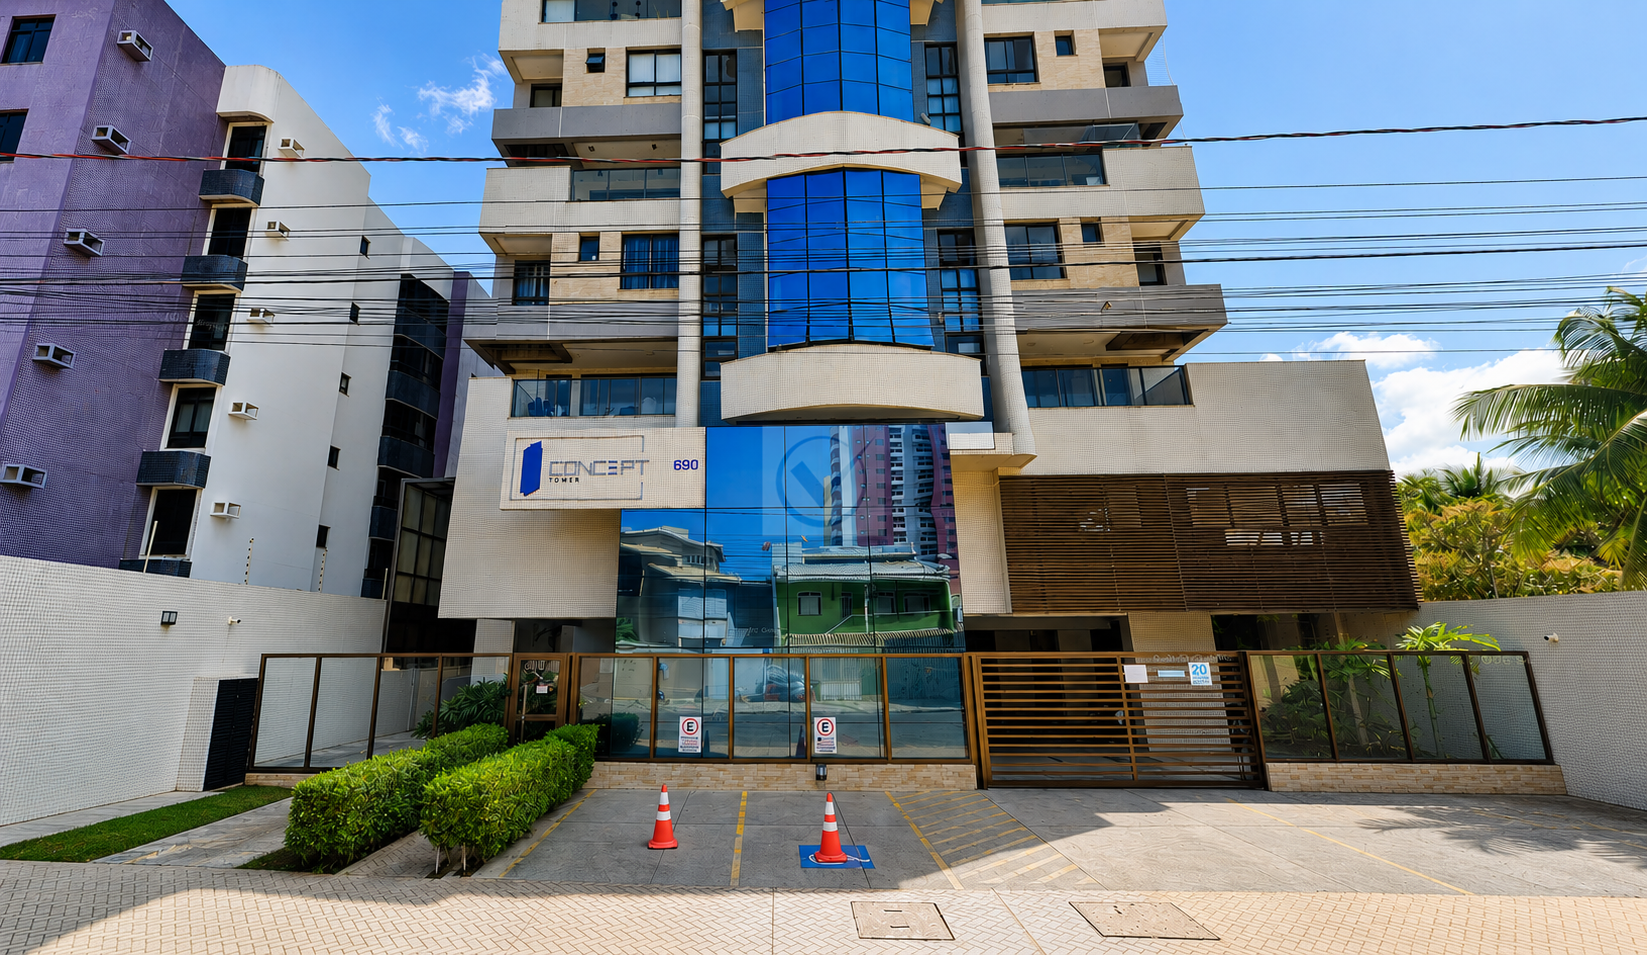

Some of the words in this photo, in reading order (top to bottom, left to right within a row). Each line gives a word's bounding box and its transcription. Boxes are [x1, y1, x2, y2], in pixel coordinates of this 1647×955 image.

[548, 460, 650, 476] CONCEPT
[673, 459, 699, 471] 690
[686, 721, 695, 732] E
[821, 721, 830, 733] E
